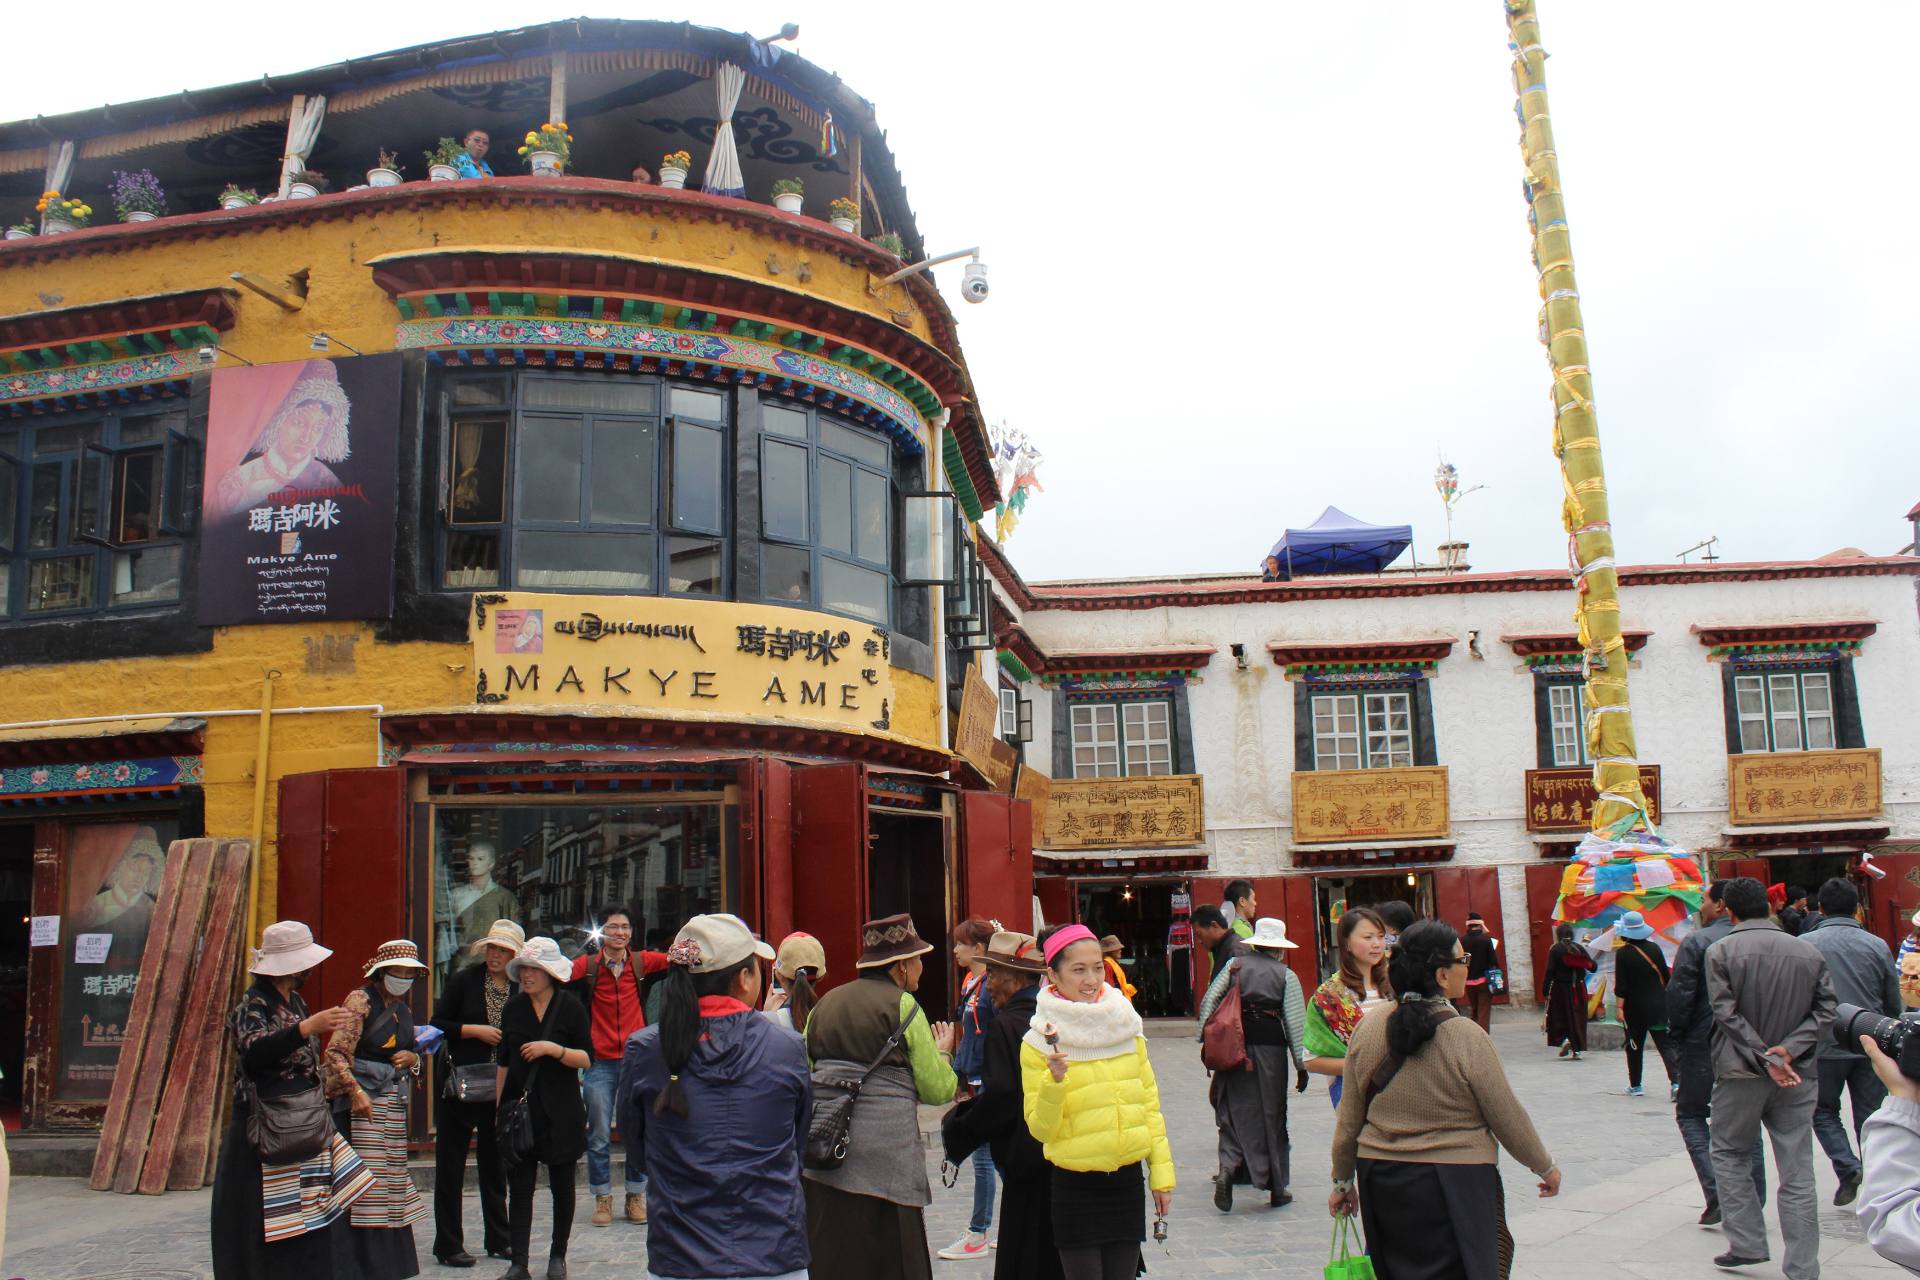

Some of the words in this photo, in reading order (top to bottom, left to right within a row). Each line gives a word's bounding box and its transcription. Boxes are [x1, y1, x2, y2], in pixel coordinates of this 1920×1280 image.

[248, 500, 341, 532] 瑪吉阿米
[247, 555, 296, 565] Makye
[303, 552, 338, 561] Ame
[736, 624, 841, 666] 瑪吉阿米
[504, 663, 719, 698] MAKYE
[762, 675, 861, 710] AME
